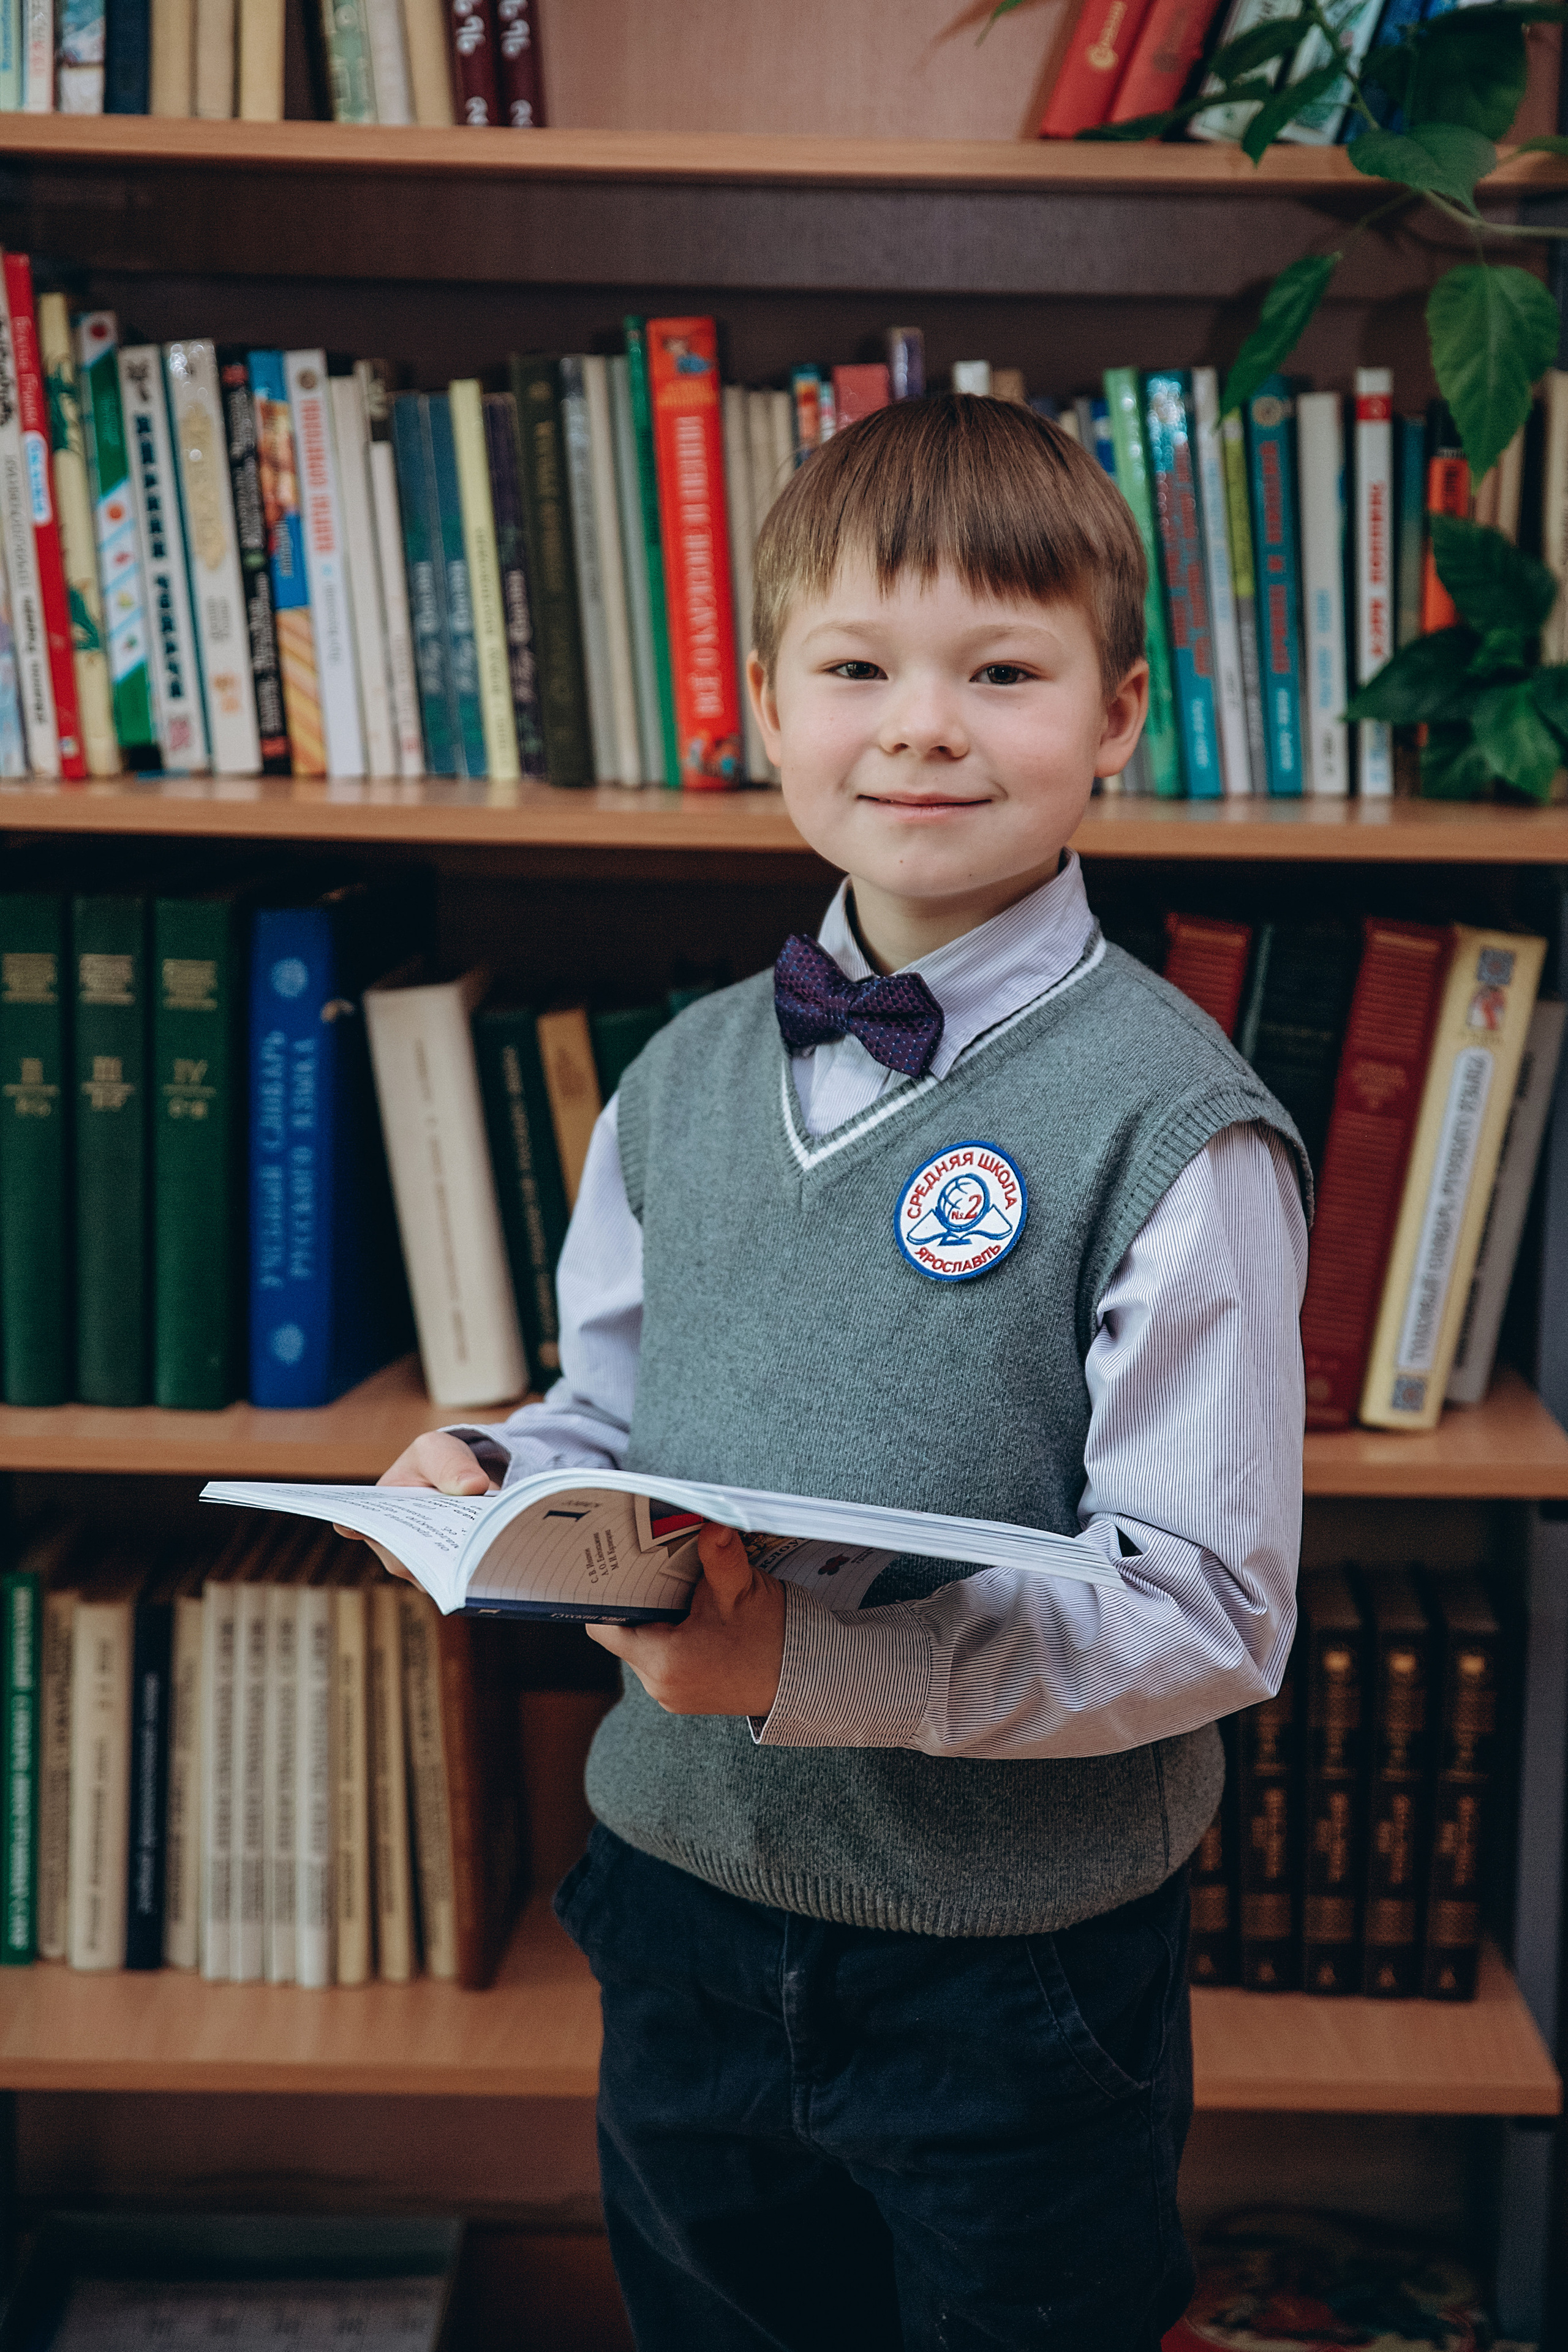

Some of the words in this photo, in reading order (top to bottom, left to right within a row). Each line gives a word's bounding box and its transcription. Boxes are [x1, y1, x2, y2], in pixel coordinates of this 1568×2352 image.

[907, 1152, 974, 1219] СРЕДНЯЯ
[978, 1153, 1017, 1210] ШКОЛА
[914, 1245, 1001, 1273] ЯРОСЛАВЛЬ
[543, 1510, 592, 1523] 1
